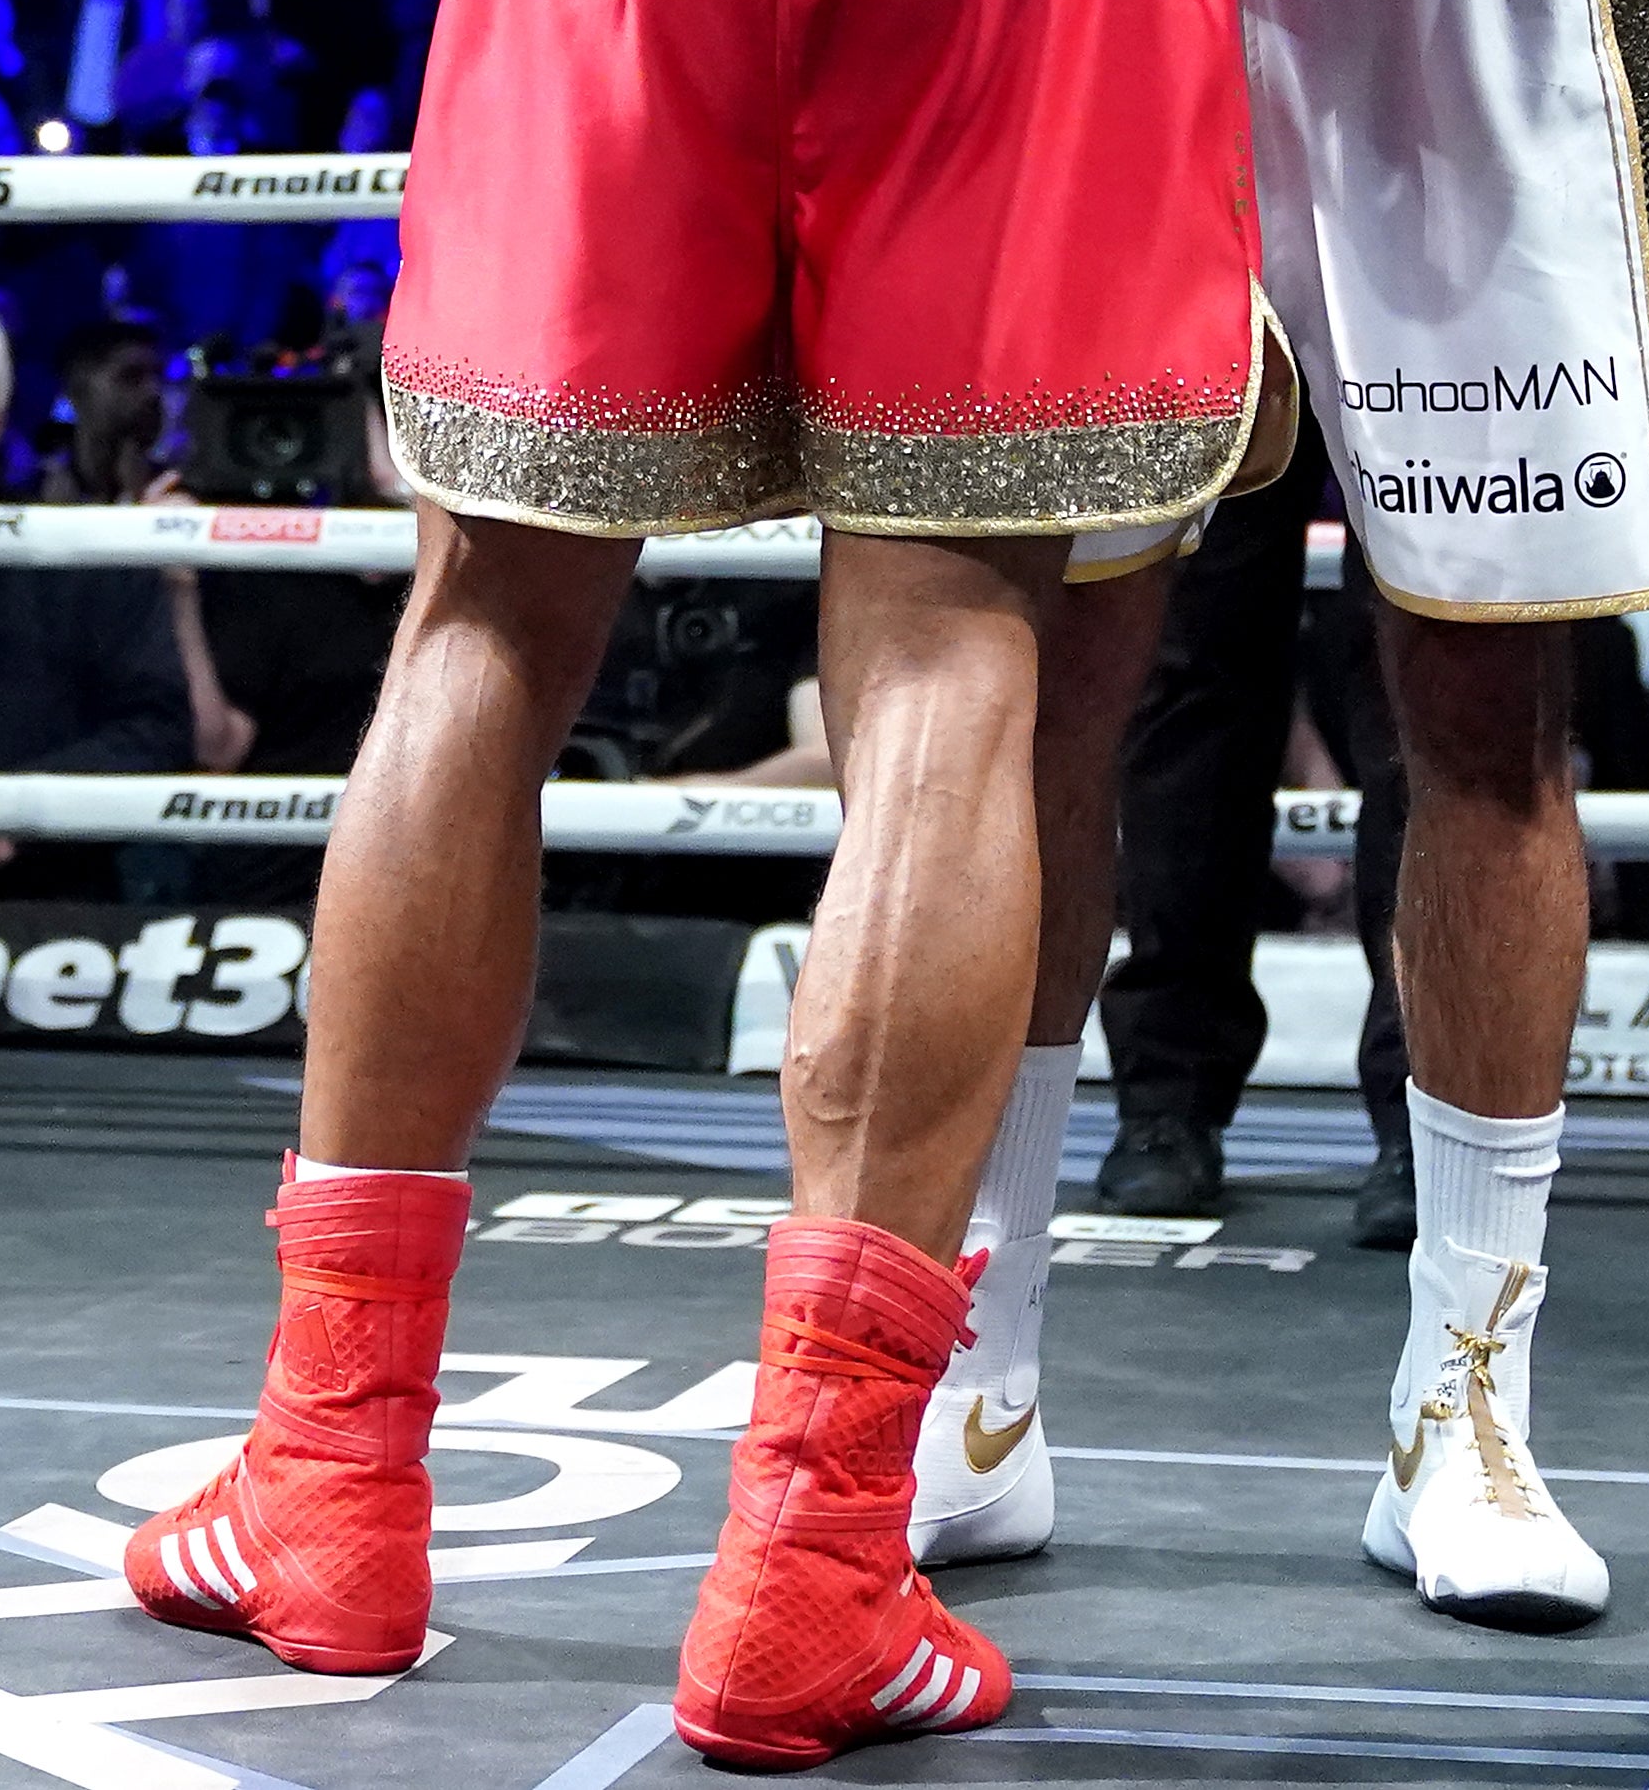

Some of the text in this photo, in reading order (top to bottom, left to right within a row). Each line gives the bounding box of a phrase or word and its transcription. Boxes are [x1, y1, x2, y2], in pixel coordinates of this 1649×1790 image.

[193, 170, 361, 195] Arnold
[1342, 356, 1618, 413] oohooMAN
[1352, 450, 1565, 514] haiiwala
[161, 791, 337, 820] Arnold
